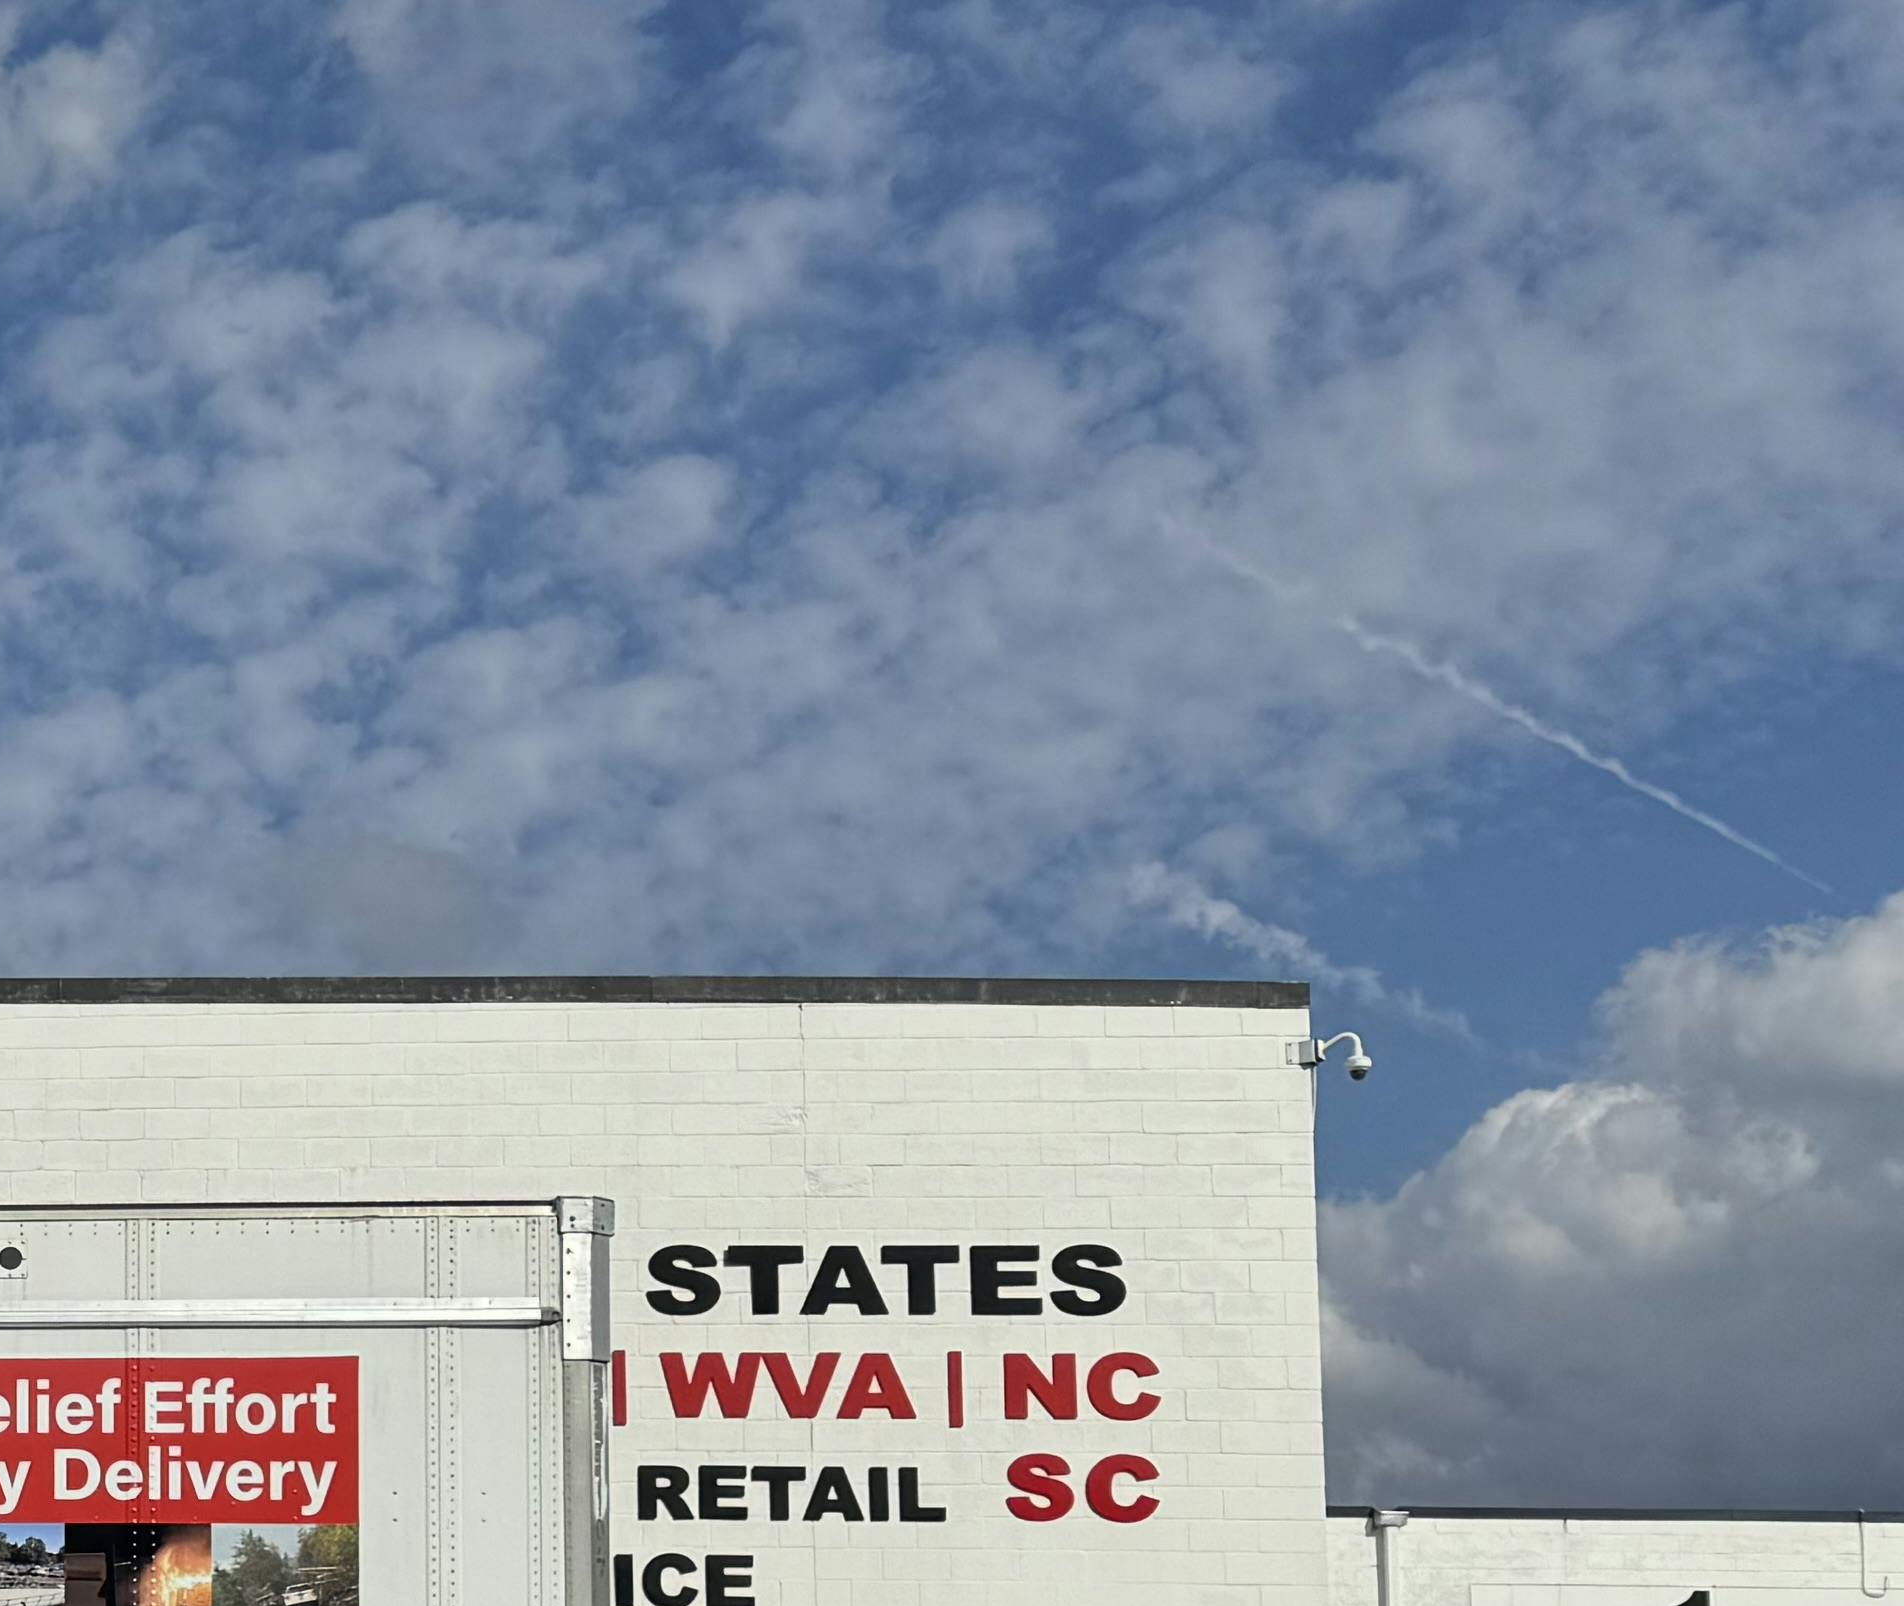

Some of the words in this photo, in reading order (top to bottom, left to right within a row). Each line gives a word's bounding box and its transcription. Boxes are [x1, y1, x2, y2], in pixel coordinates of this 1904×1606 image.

[646, 1245, 1127, 1316] STATES
[144, 1377, 337, 1434] Effort
[661, 1353, 916, 1419] WVA
[1004, 1353, 1161, 1420] NC
[54, 1446, 338, 1515] Delivery
[637, 1466, 947, 1522] RETAIL
[1006, 1454, 1160, 1522] SC
